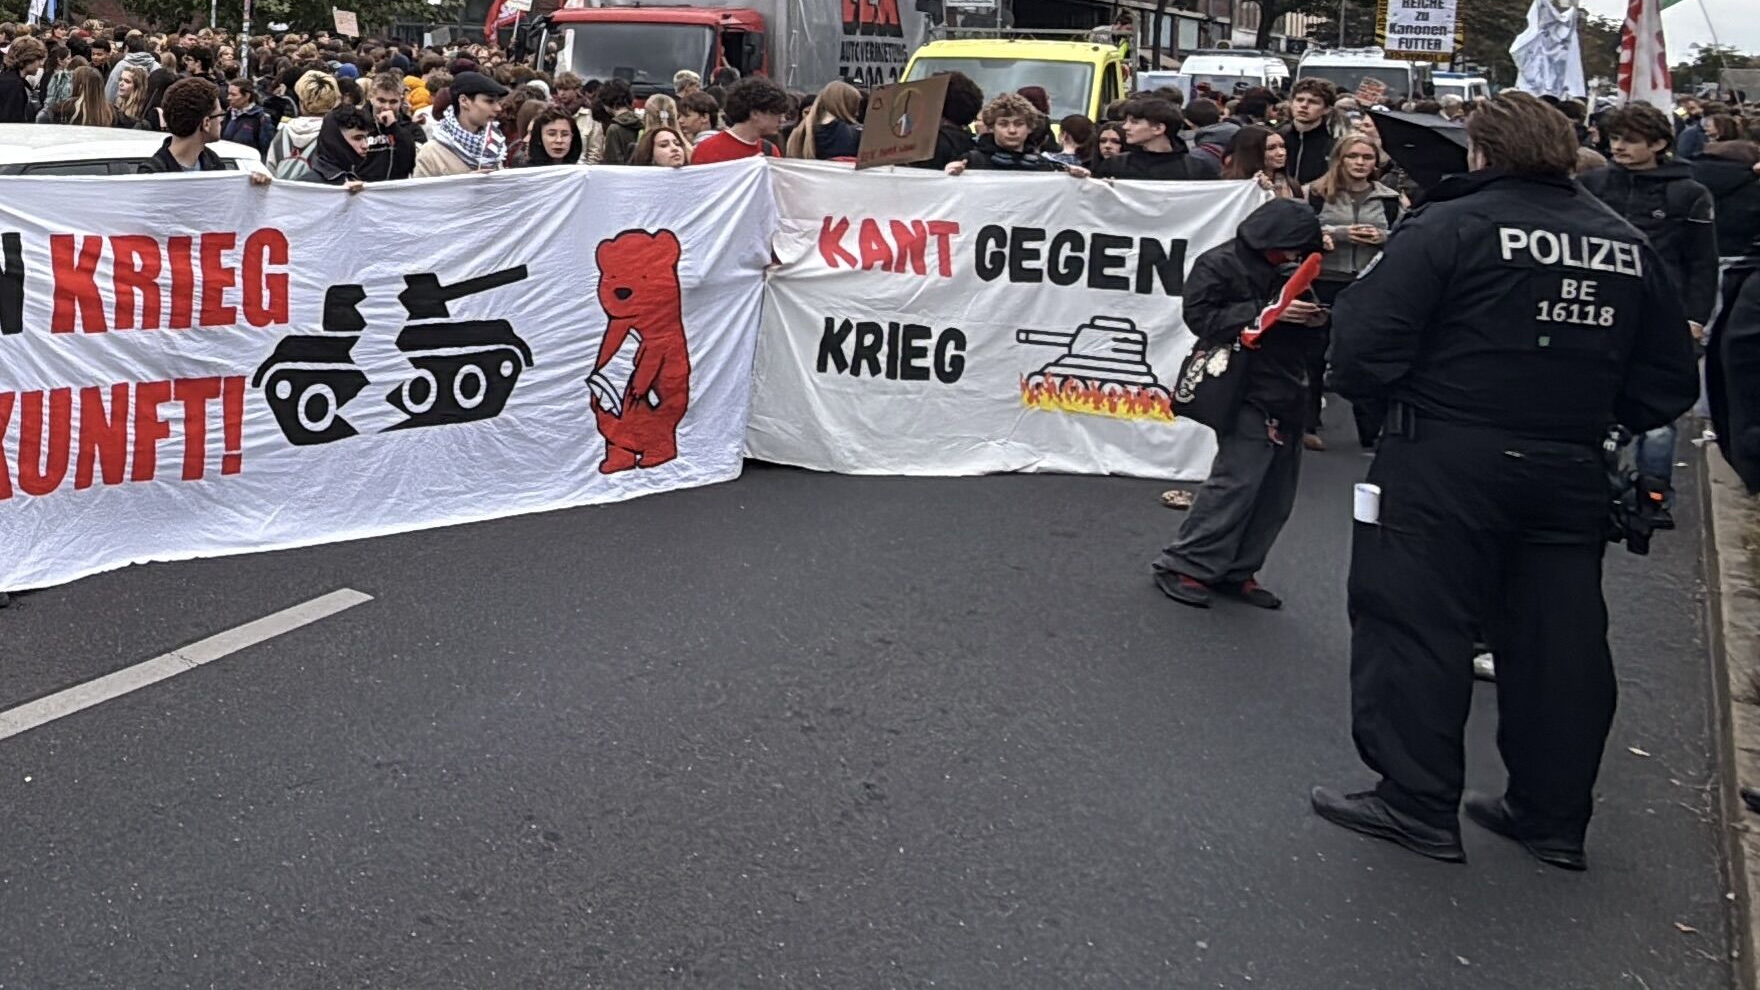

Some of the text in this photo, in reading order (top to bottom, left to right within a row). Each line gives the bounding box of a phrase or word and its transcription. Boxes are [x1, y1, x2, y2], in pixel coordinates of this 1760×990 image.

[1398, 37, 1443, 51] FUTTER
[818, 216, 1188, 297] KANT GEGEN
[1499, 227, 1643, 278] POLIZEI
[52, 227, 291, 334] KRIEG
[1561, 278, 1598, 301] BE
[1536, 301, 1616, 327] 16118
[817, 317, 967, 384] KRIEG
